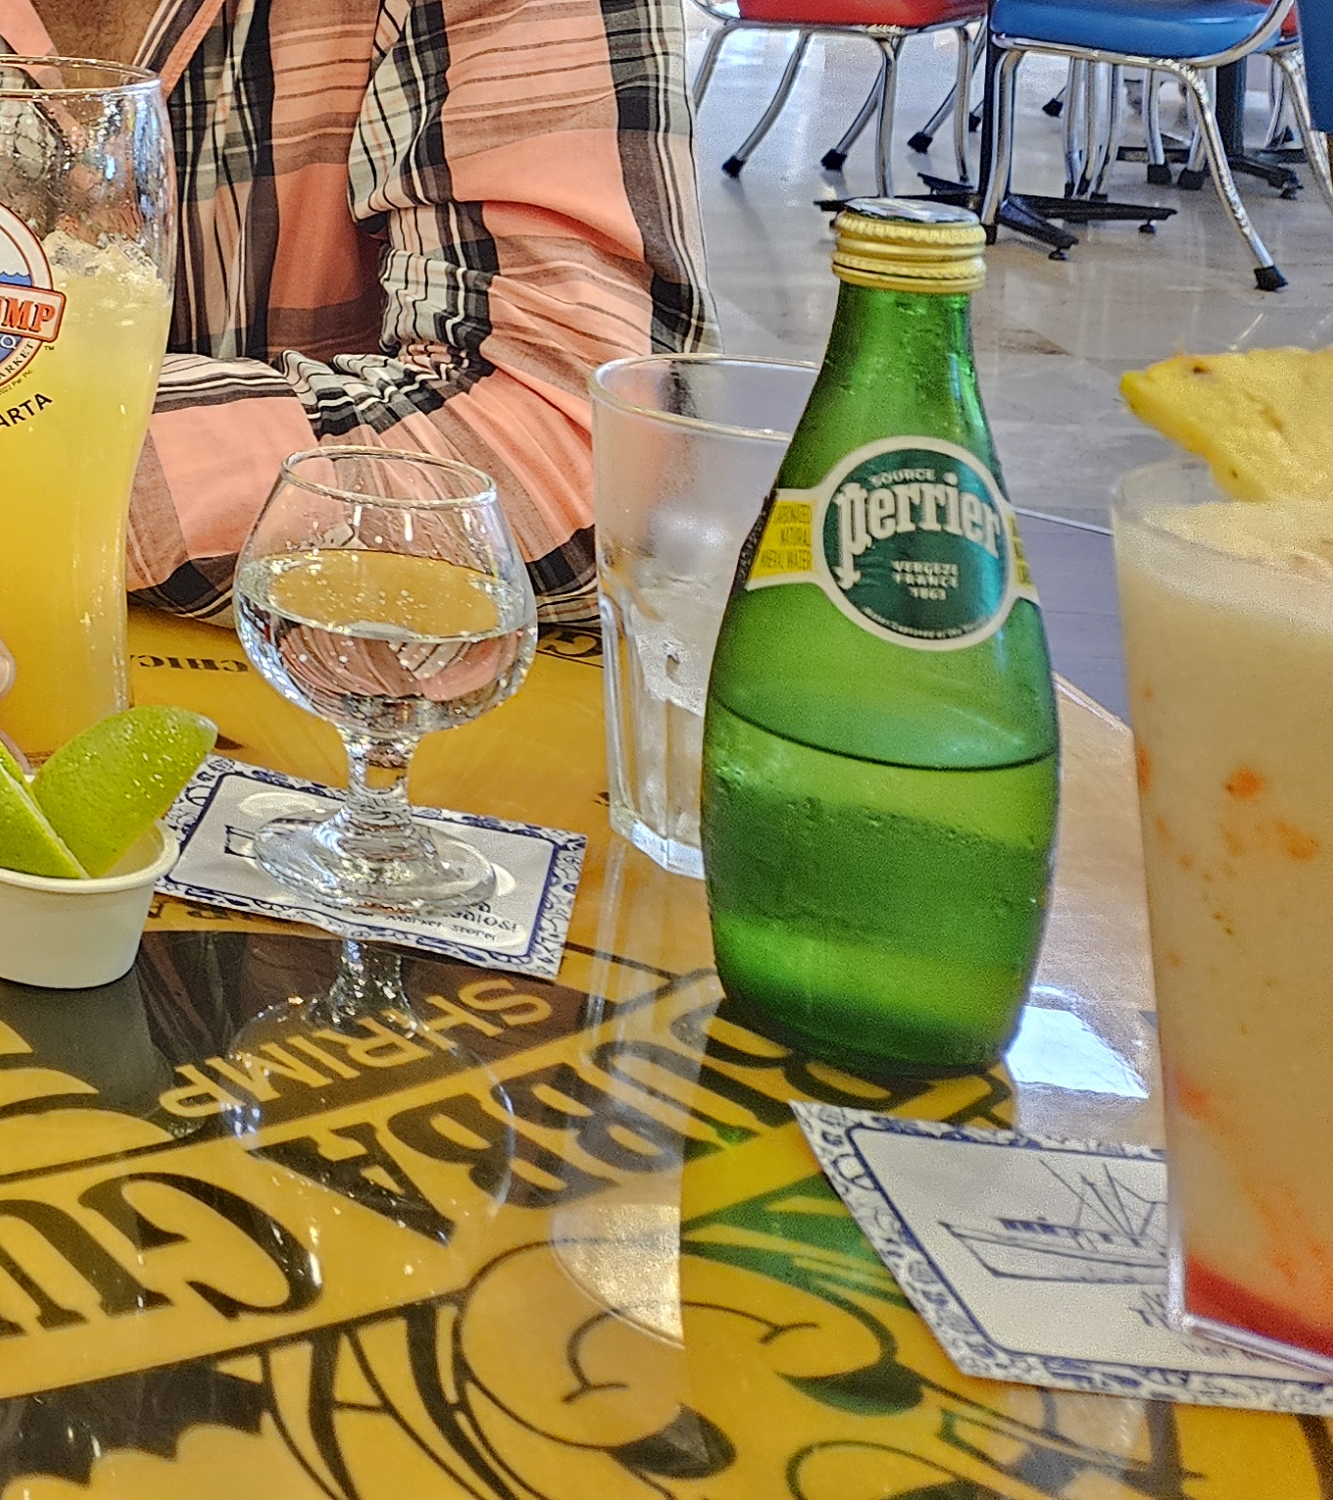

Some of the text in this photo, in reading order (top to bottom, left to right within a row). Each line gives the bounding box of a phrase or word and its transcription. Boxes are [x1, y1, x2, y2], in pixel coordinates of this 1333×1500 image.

[869, 468, 935, 488] SOURCE
[893, 573, 959, 588] FRANCE
[158, 978, 553, 1119] SHRIMP
